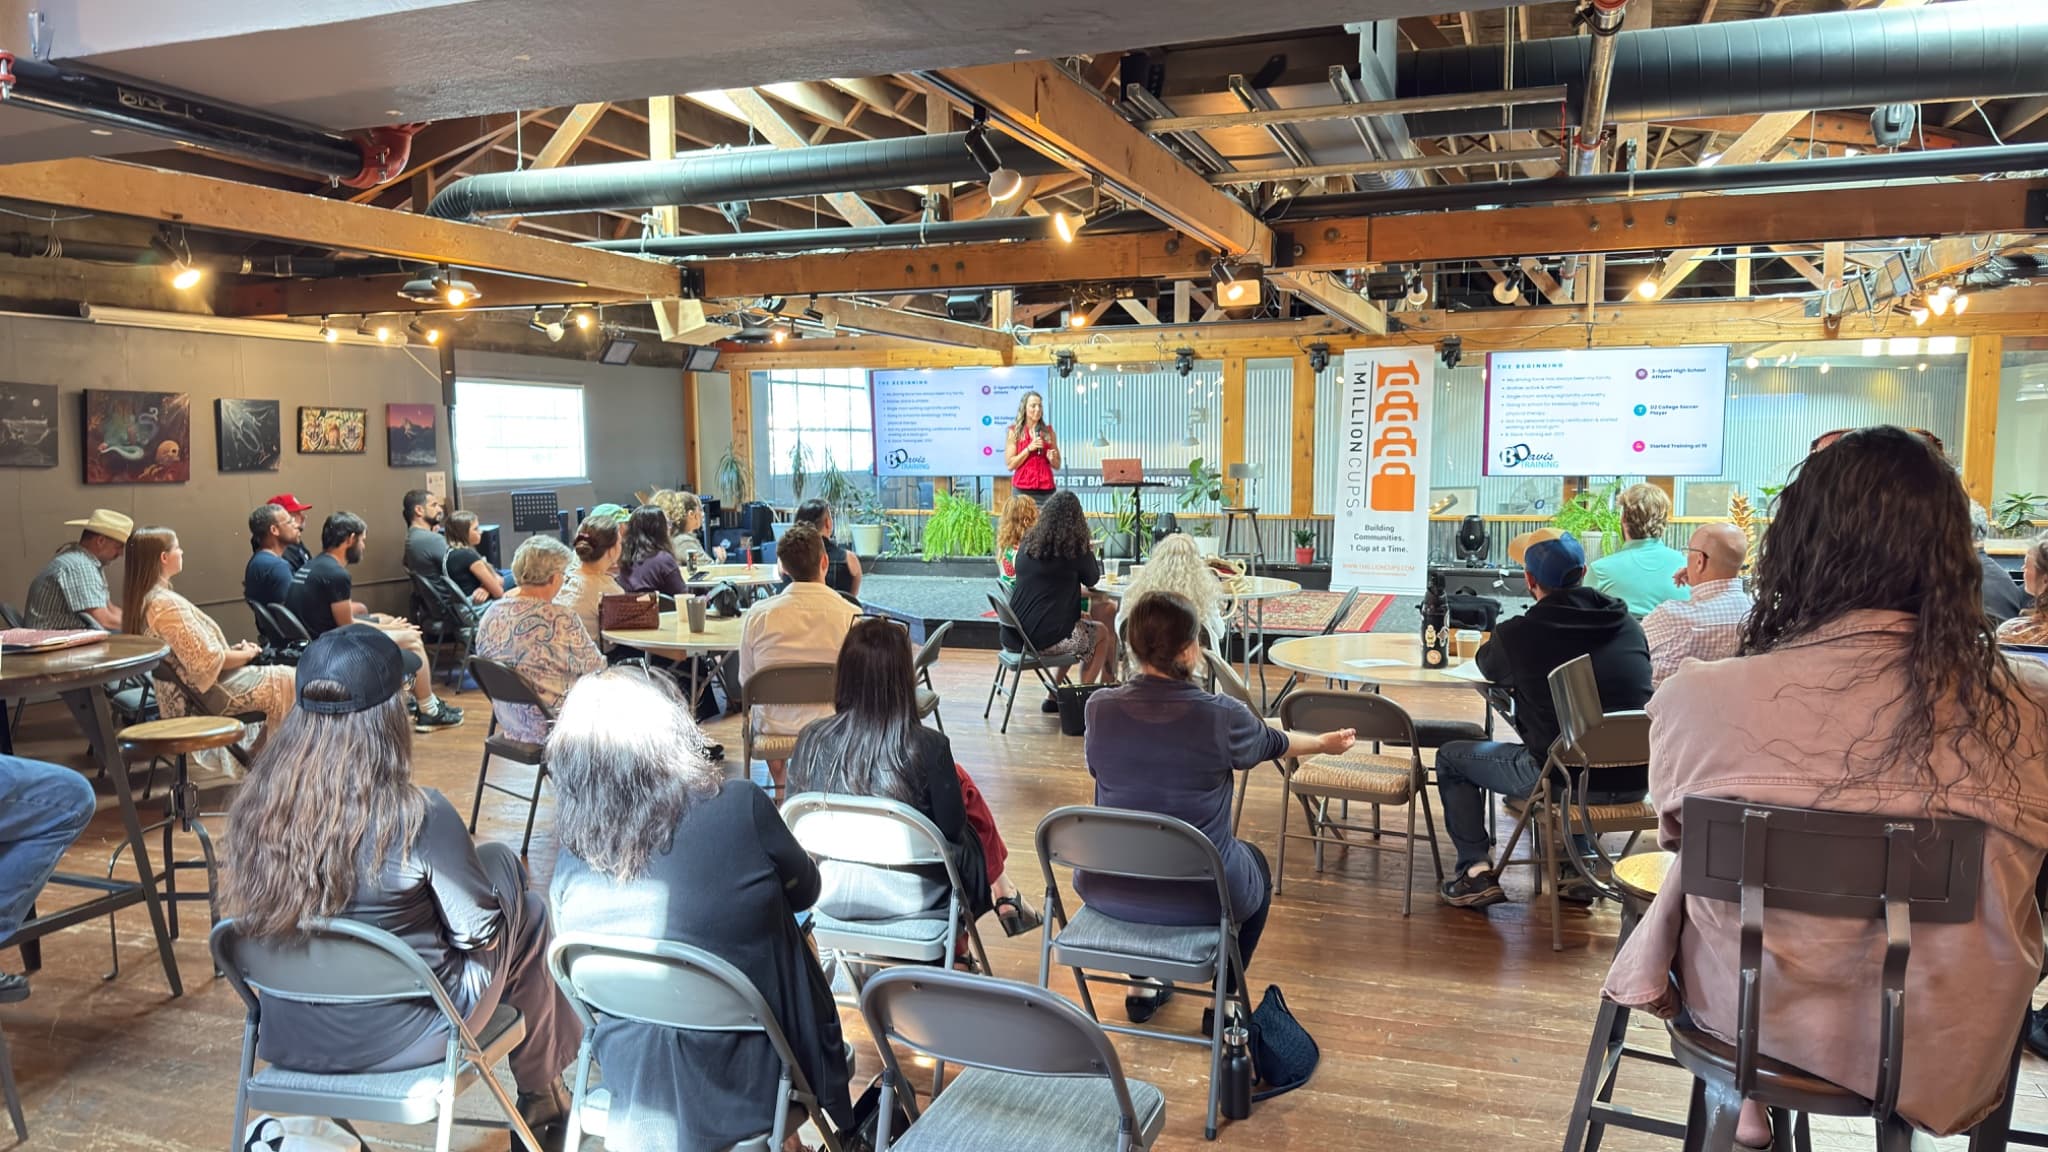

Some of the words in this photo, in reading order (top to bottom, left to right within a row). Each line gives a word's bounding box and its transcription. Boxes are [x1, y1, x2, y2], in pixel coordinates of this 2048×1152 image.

[1521, 461, 1559, 469] TRAINING
[1053, 476, 1086, 486] TREET
[1143, 476, 1191, 487] OMPANY
[1364, 524, 1395, 533] Building
[1353, 533, 1405, 542] Communities.
[1356, 544, 1370, 553] Cup
[1388, 545, 1409, 553] Time.
